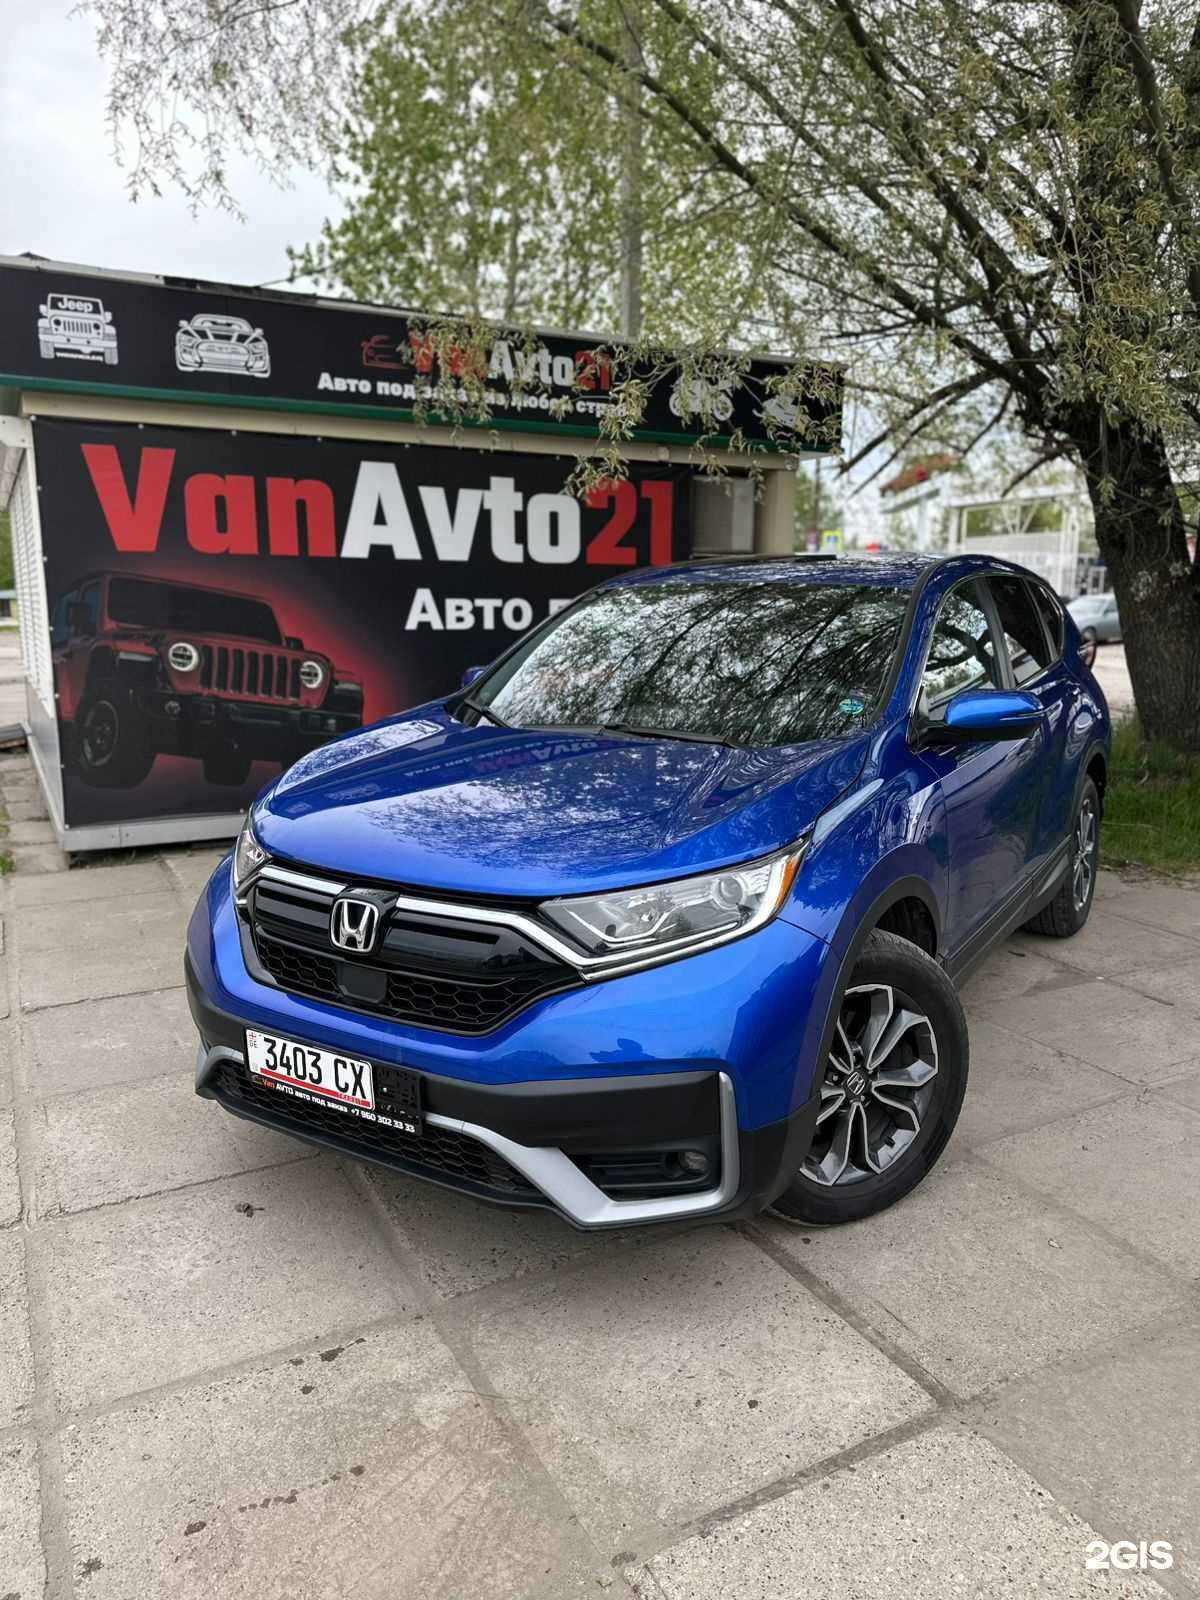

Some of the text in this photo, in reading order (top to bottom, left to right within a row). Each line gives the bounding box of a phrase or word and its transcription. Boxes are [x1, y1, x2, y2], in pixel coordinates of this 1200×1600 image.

[57, 297, 94, 313] Jeep
[317, 371, 372, 394] Авто
[376, 378, 417, 400] под
[79, 442, 674, 566] VanAvto21
[404, 587, 534, 631] Авто
[263, 1036, 367, 1100] 3403 CX
[377, 1114, 393, 1127] 302
